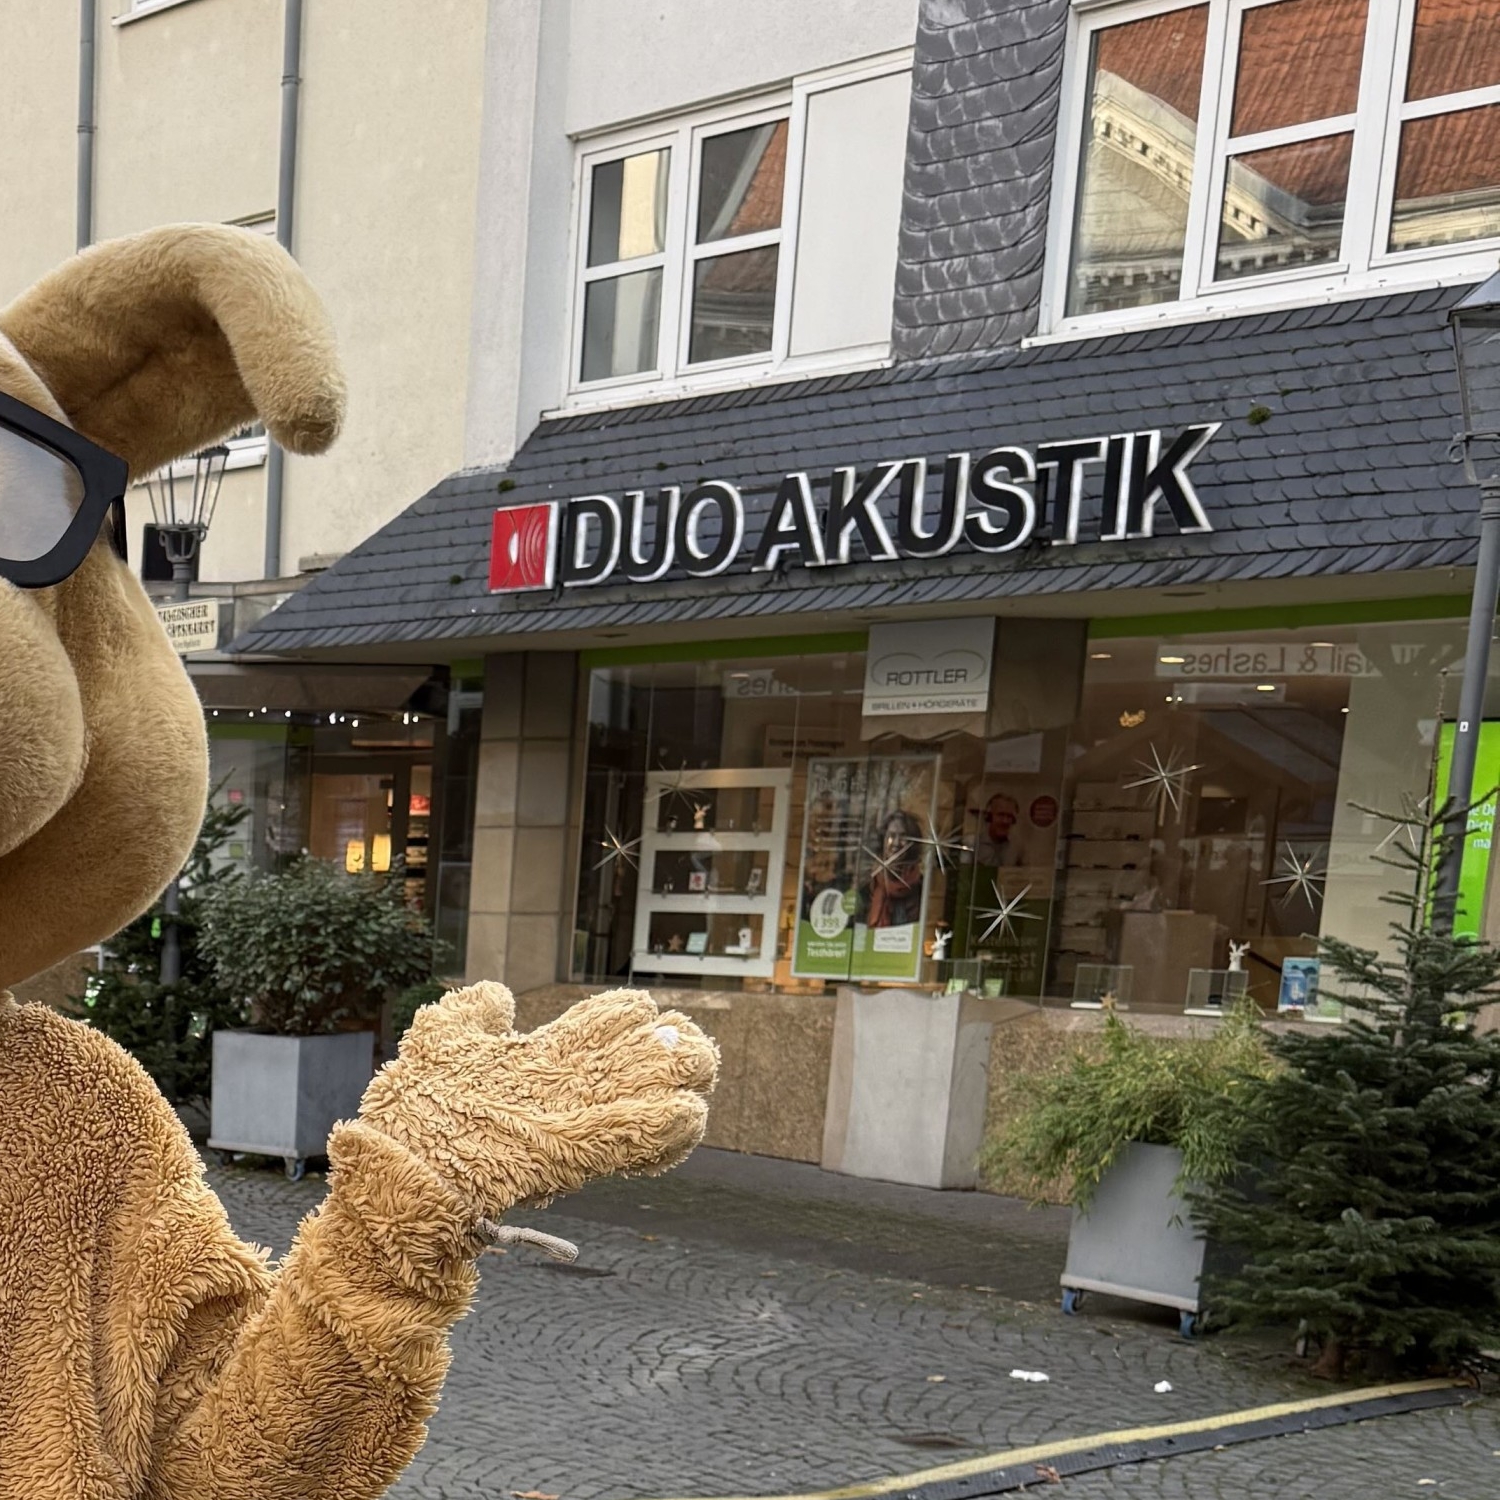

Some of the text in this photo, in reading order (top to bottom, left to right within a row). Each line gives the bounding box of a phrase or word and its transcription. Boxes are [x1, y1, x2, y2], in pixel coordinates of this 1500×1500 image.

[563, 422, 1222, 588] DUO AKUSTIK
[886, 668, 968, 686] ROTTLER
